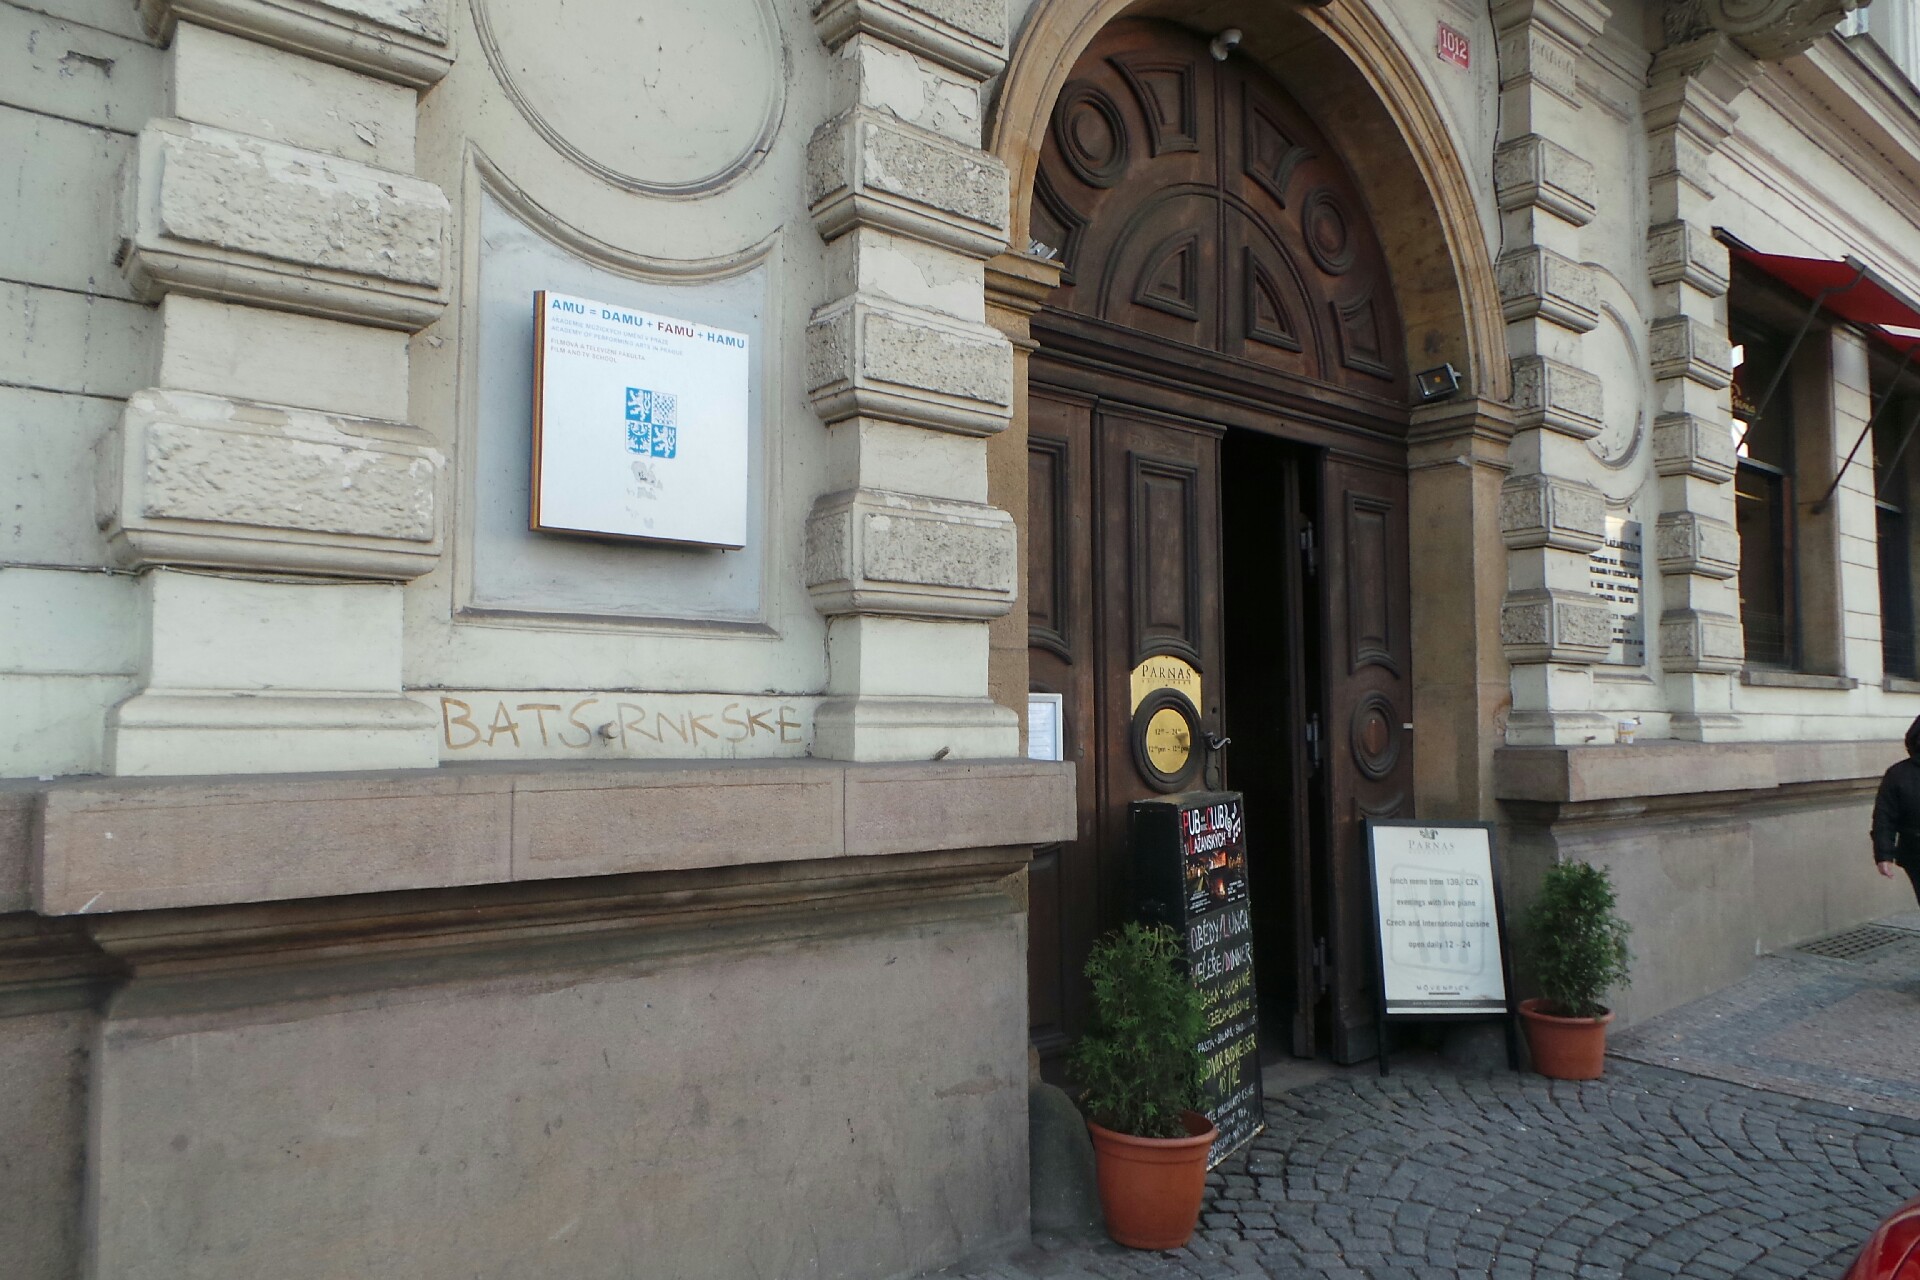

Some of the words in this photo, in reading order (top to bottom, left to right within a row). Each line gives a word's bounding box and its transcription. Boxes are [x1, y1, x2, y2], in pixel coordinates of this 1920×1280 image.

[1443, 29, 1467, 59] 1012
[552, 299, 584, 315] AMU
[602, 309, 643, 327] DAMU
[657, 321, 694, 338] FAMU
[707, 331, 745, 349] HAMU
[551, 326, 581, 336] ACADEMY
[594, 333, 634, 347] PERFORMING
[635, 341, 651, 351] ARTS
[660, 346, 683, 357] PRAGUE
[550, 346, 566, 354] FILM
[567, 349, 581, 357] AND
[592, 352, 617, 364] SCHOOL
[618, 350, 645, 361] FAKULTA
[1142, 664, 1191, 680] PARNAS
[1182, 809, 1201, 836] PUB
[1206, 804, 1225, 830] CLUB
[1408, 839, 1456, 850] PARNAS
[1389, 877, 1408, 885] lunch
[1429, 877, 1444, 886] from
[1465, 878, 1479, 887] CZK
[1396, 899, 1426, 908] evenings
[1427, 898, 1442, 907] with
[1443, 899, 1456, 907] live
[1457, 899, 1477, 909] piano
[1386, 918, 1406, 927] Czech
[1408, 919, 1421, 928] and
[1422, 919, 1464, 928] international
[1465, 920, 1491, 928] cuisine
[1408, 941, 1425, 949] open
[1426, 940, 1443, 949] daily
[1444, 941, 1454, 949] 12
[1462, 941, 1472, 949] 24
